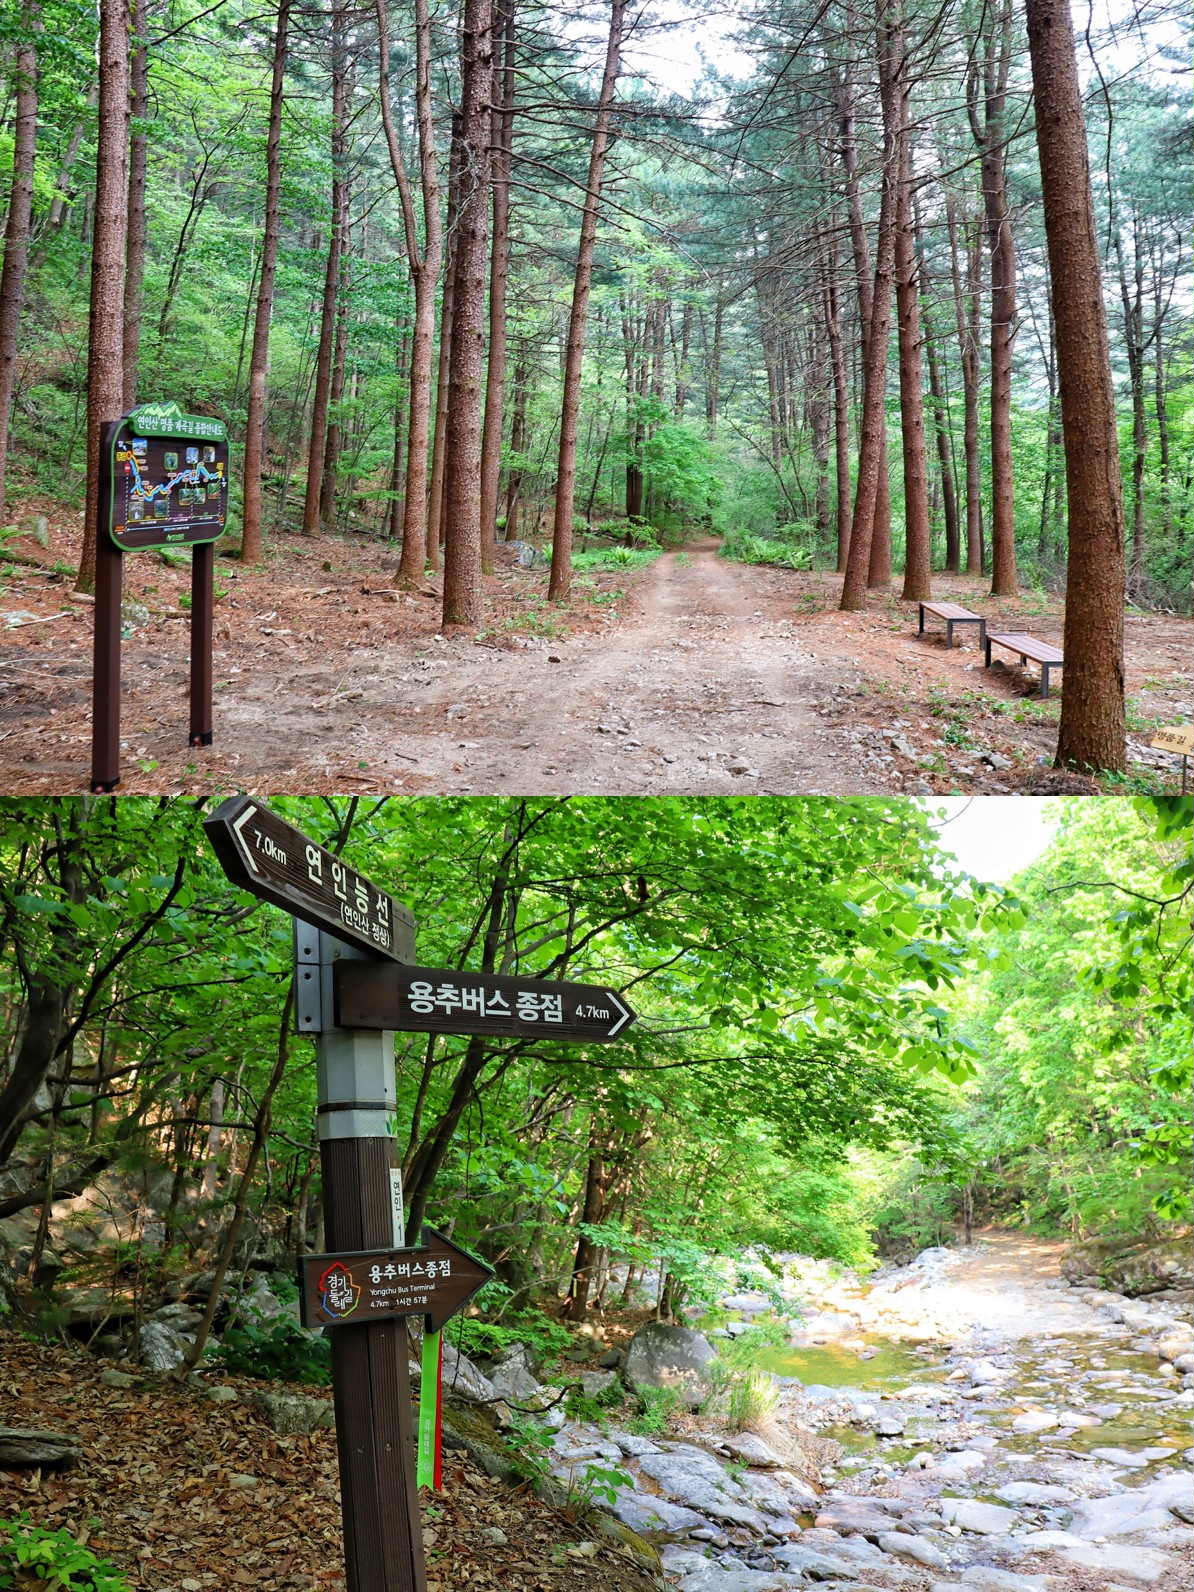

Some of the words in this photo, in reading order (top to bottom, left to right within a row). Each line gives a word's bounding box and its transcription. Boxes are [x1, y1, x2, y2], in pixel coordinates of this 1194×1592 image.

[138, 415, 158, 430] 연인산
[161, 418, 173, 431] 명품
[175, 419, 193, 434] 계곡길
[195, 422, 223, 435] 종합안내도
[254, 830, 287, 865] 7.0km
[340, 901, 369, 936] (연인산
[371, 922, 390, 949] 정상)
[407, 981, 512, 1018] 용추버스
[515, 991, 563, 1023] 종점
[575, 1005, 610, 1019] 4.7km
[368, 1259, 451, 1284] 용추버스종점
[369, 1287, 397, 1297] Yongchu
[409, 1283, 436, 1292] Terminal
[370, 1300, 390, 1308] 4.7km
[395, 1298, 412, 1306] 1시간
[413, 1295, 428, 1304] 57분
